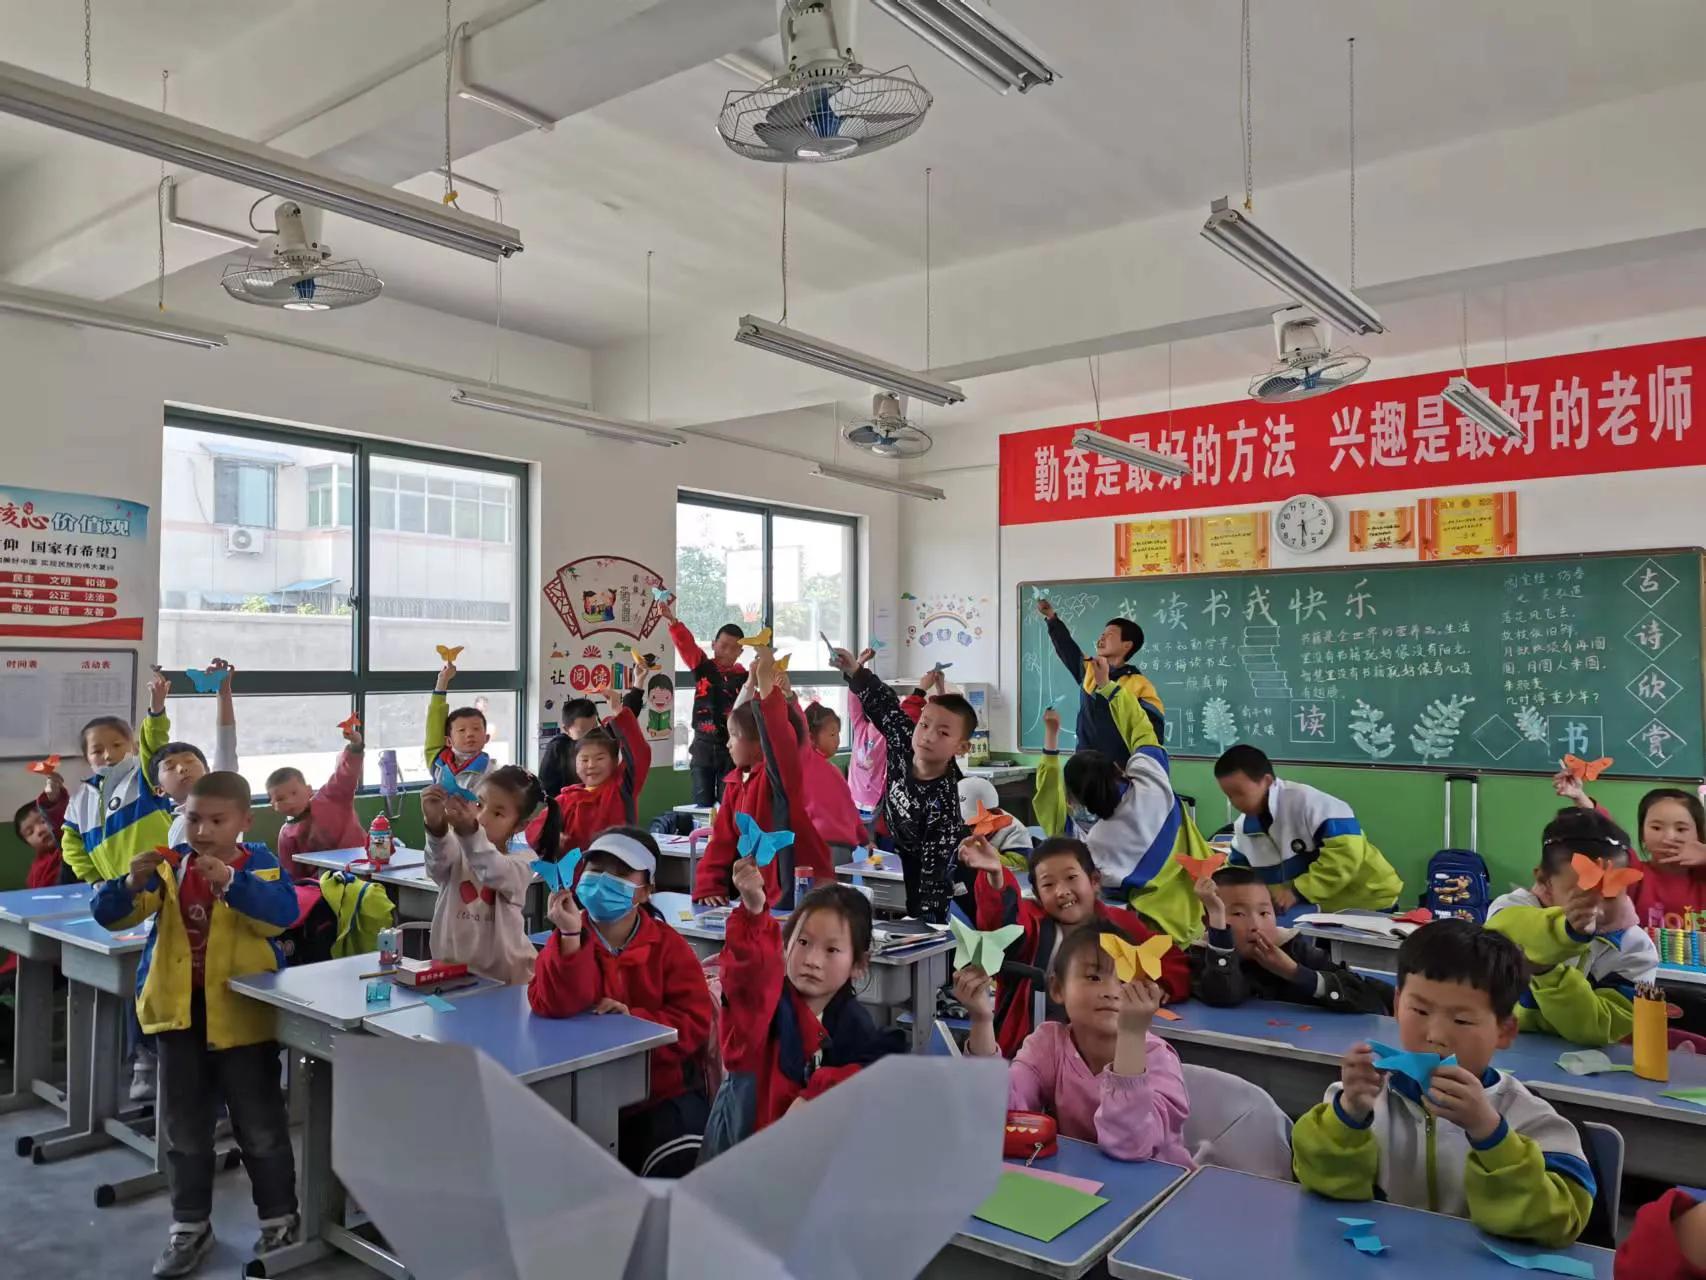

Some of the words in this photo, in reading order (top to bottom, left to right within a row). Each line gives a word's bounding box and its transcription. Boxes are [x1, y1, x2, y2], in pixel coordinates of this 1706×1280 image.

[1034, 414, 1296, 502] 勤奋是最好的方法
[1329, 365, 1692, 472] 兴趣是最好的老师
[13, 573, 34, 583] 民主
[50, 576, 71, 586] 文明
[86, 579, 106, 588] 和谐
[12, 588, 34, 598] 平等
[49, 591, 70, 600] 公正
[85, 593, 105, 602] 法治
[12, 604, 34, 613] 敬业
[49, 606, 70, 615] 诚信
[84, 607, 105, 617] 友善
[6, 660, 38, 669] 时间表
[81, 660, 111, 669] 活动表
[1294, 703, 1327, 738] 读
[1558, 721, 1590, 755] 书
